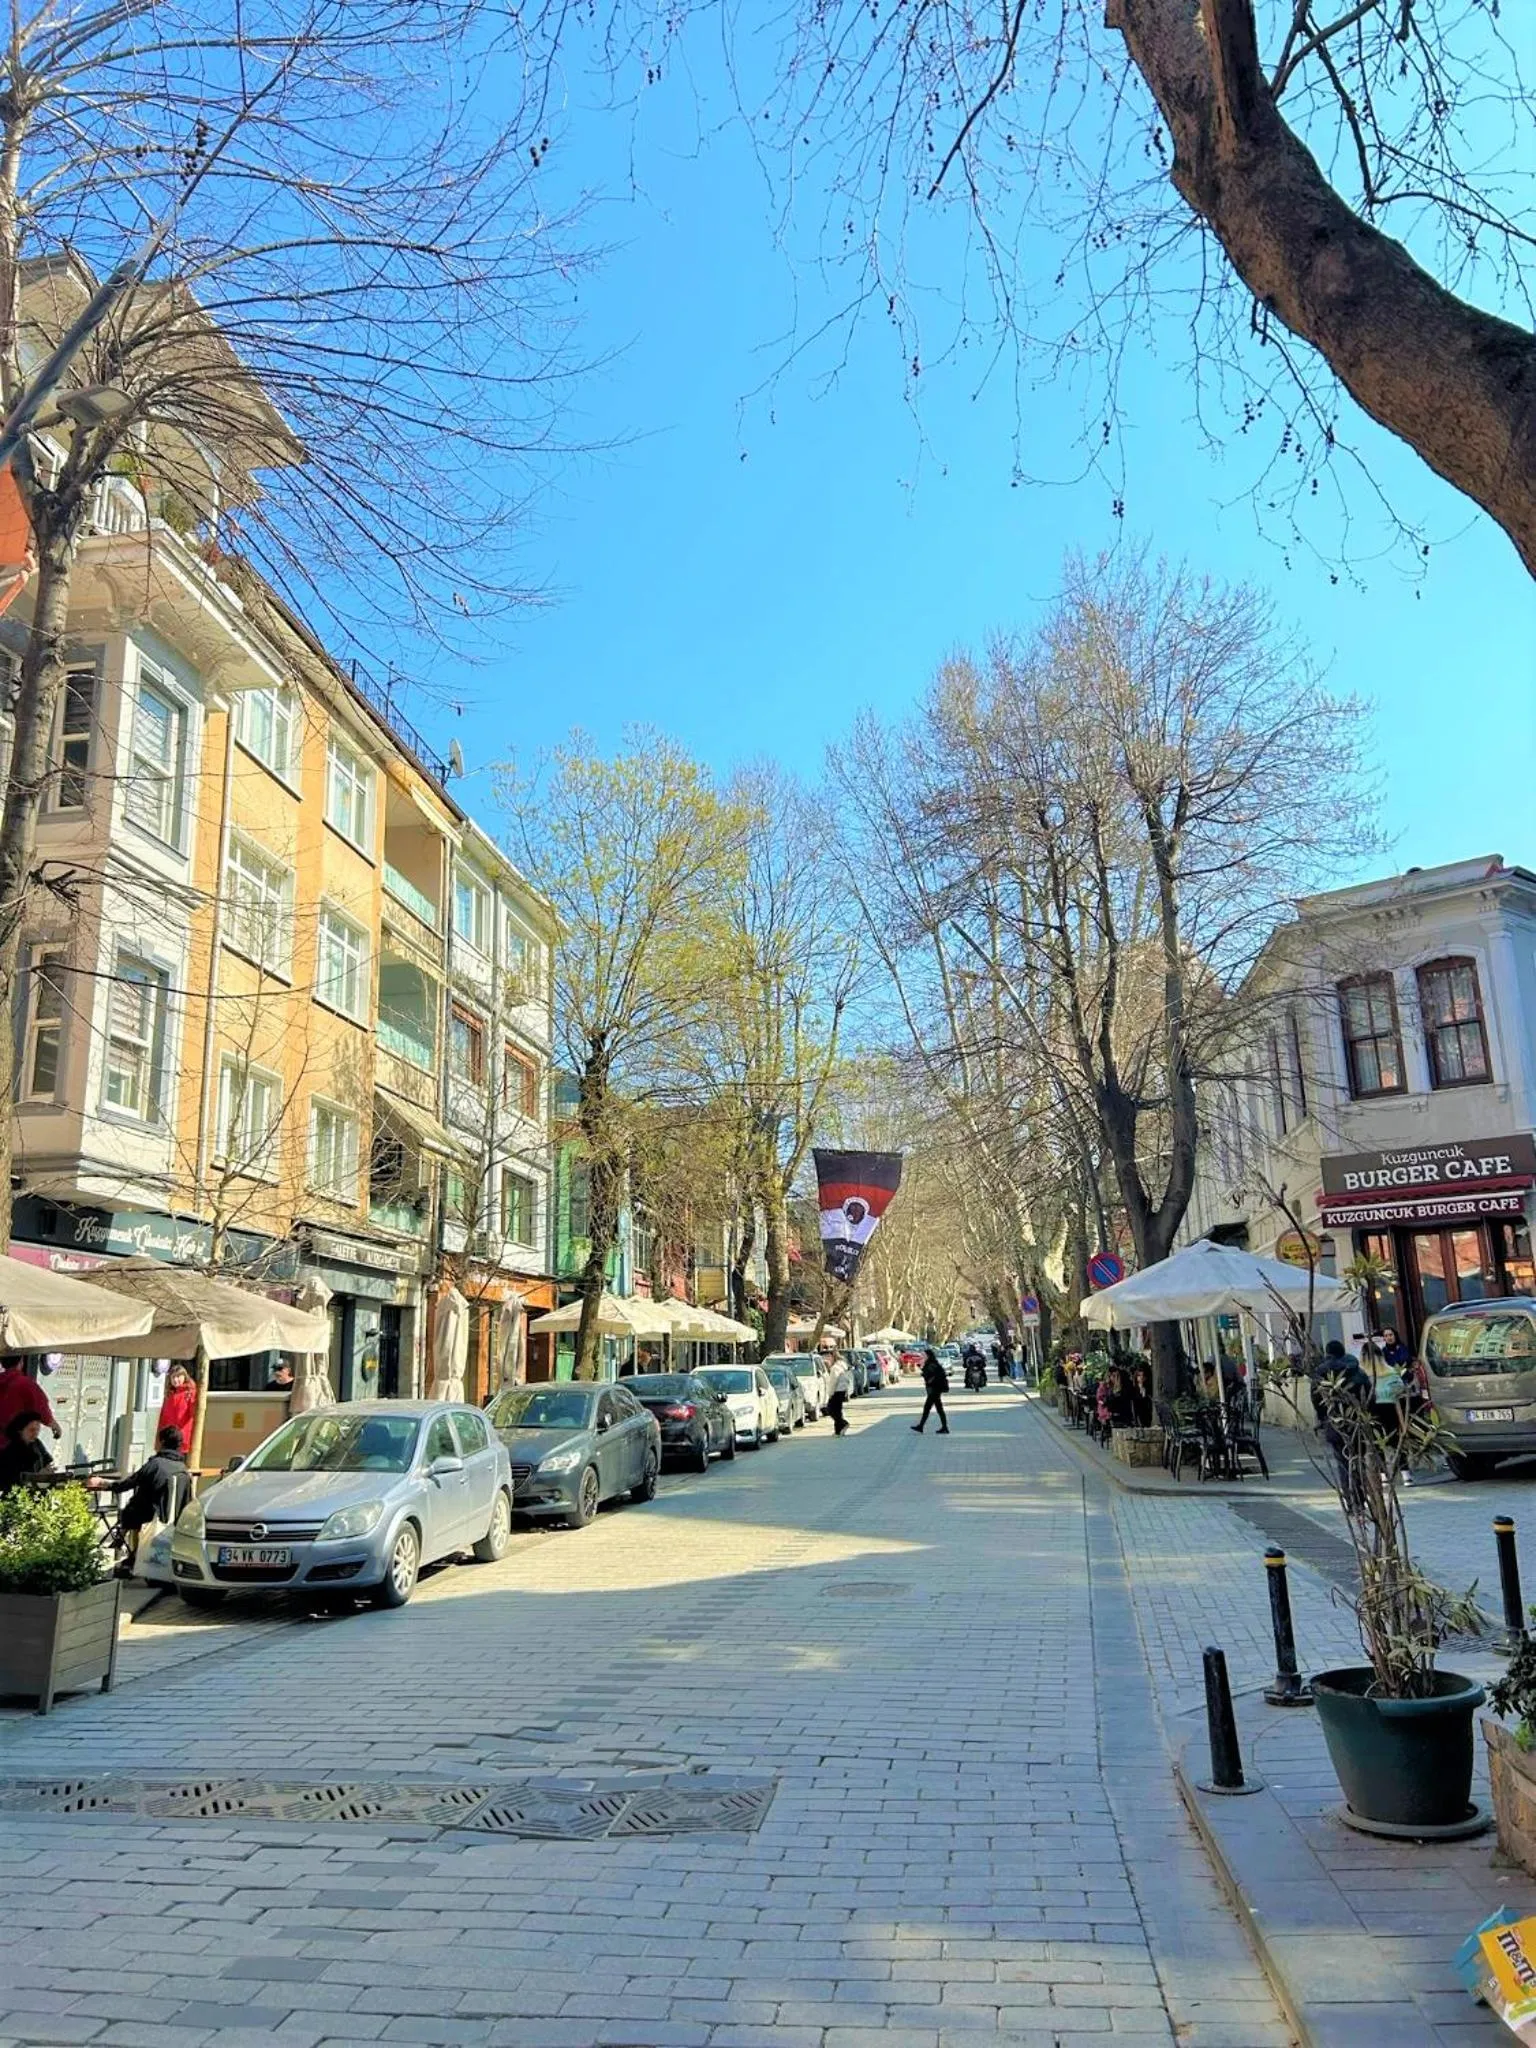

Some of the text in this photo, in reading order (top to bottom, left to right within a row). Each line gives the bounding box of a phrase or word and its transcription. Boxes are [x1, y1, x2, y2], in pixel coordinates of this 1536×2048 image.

[1381, 1145, 1464, 1165] Kuzguncuk
[1344, 1155, 1512, 1190] BURGER CAFE
[1327, 1197, 1520, 1225] KUZGUNCUK BURGER CAFE
[226, 1549, 238, 1562] 34
[260, 1550, 287, 1563] 0773
